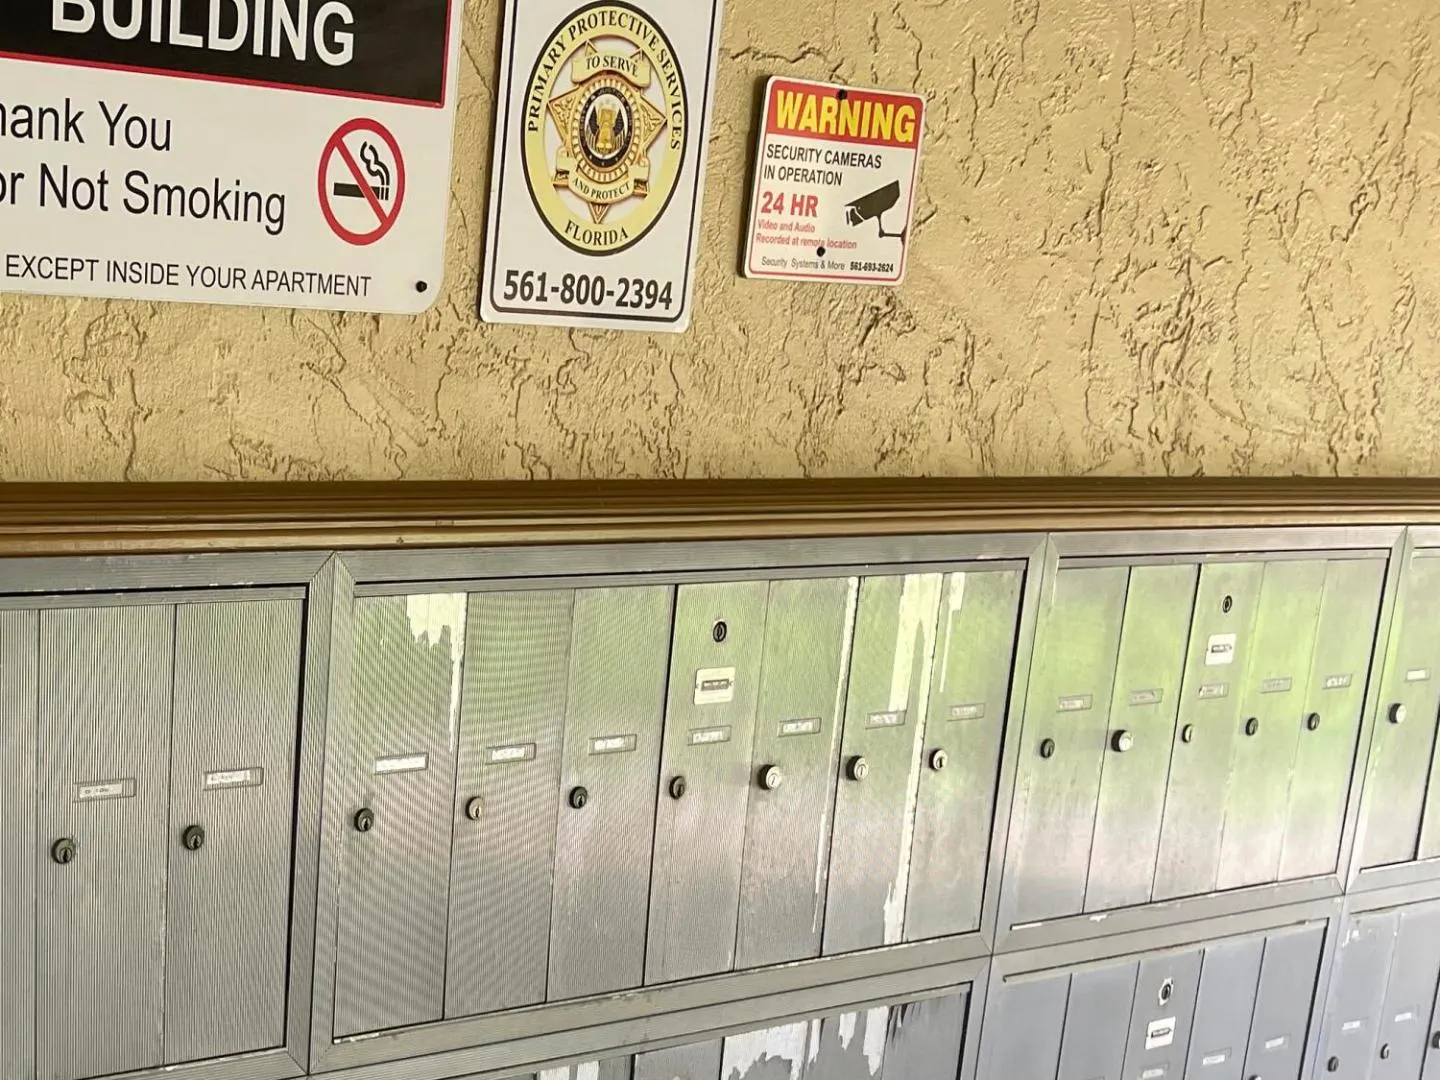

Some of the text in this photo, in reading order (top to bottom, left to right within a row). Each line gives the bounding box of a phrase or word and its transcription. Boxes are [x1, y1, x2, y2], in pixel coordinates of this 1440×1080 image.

[51, 0, 355, 66] BUILDING
[585, 55, 639, 76] TO SERVE
[527, 10, 681, 152] PRIMARY PROTECTIVE SERVICES
[98, 101, 172, 152] You
[775, 90, 916, 143] WARNING
[766, 144, 882, 169] SECURITY CAMERAS
[572, 177, 630, 200] AND PROTECT
[763, 165, 842, 186] IN OPERATION
[39, 163, 109, 212] Not
[123, 170, 286, 235] Smoking
[760, 191, 819, 217] 24 HR
[564, 219, 629, 246] FLORIDA
[758, 219, 816, 233] Video and Audio
[756, 232, 858, 250] Recorded at remote location
[5, 254, 372, 297] EXCEPT INSIDE YOUR APARTMENT
[761, 256, 787, 269] Security
[791, 257, 819, 270] Systems
[827, 259, 845, 271] More
[503, 269, 673, 310] 561-800-2394
